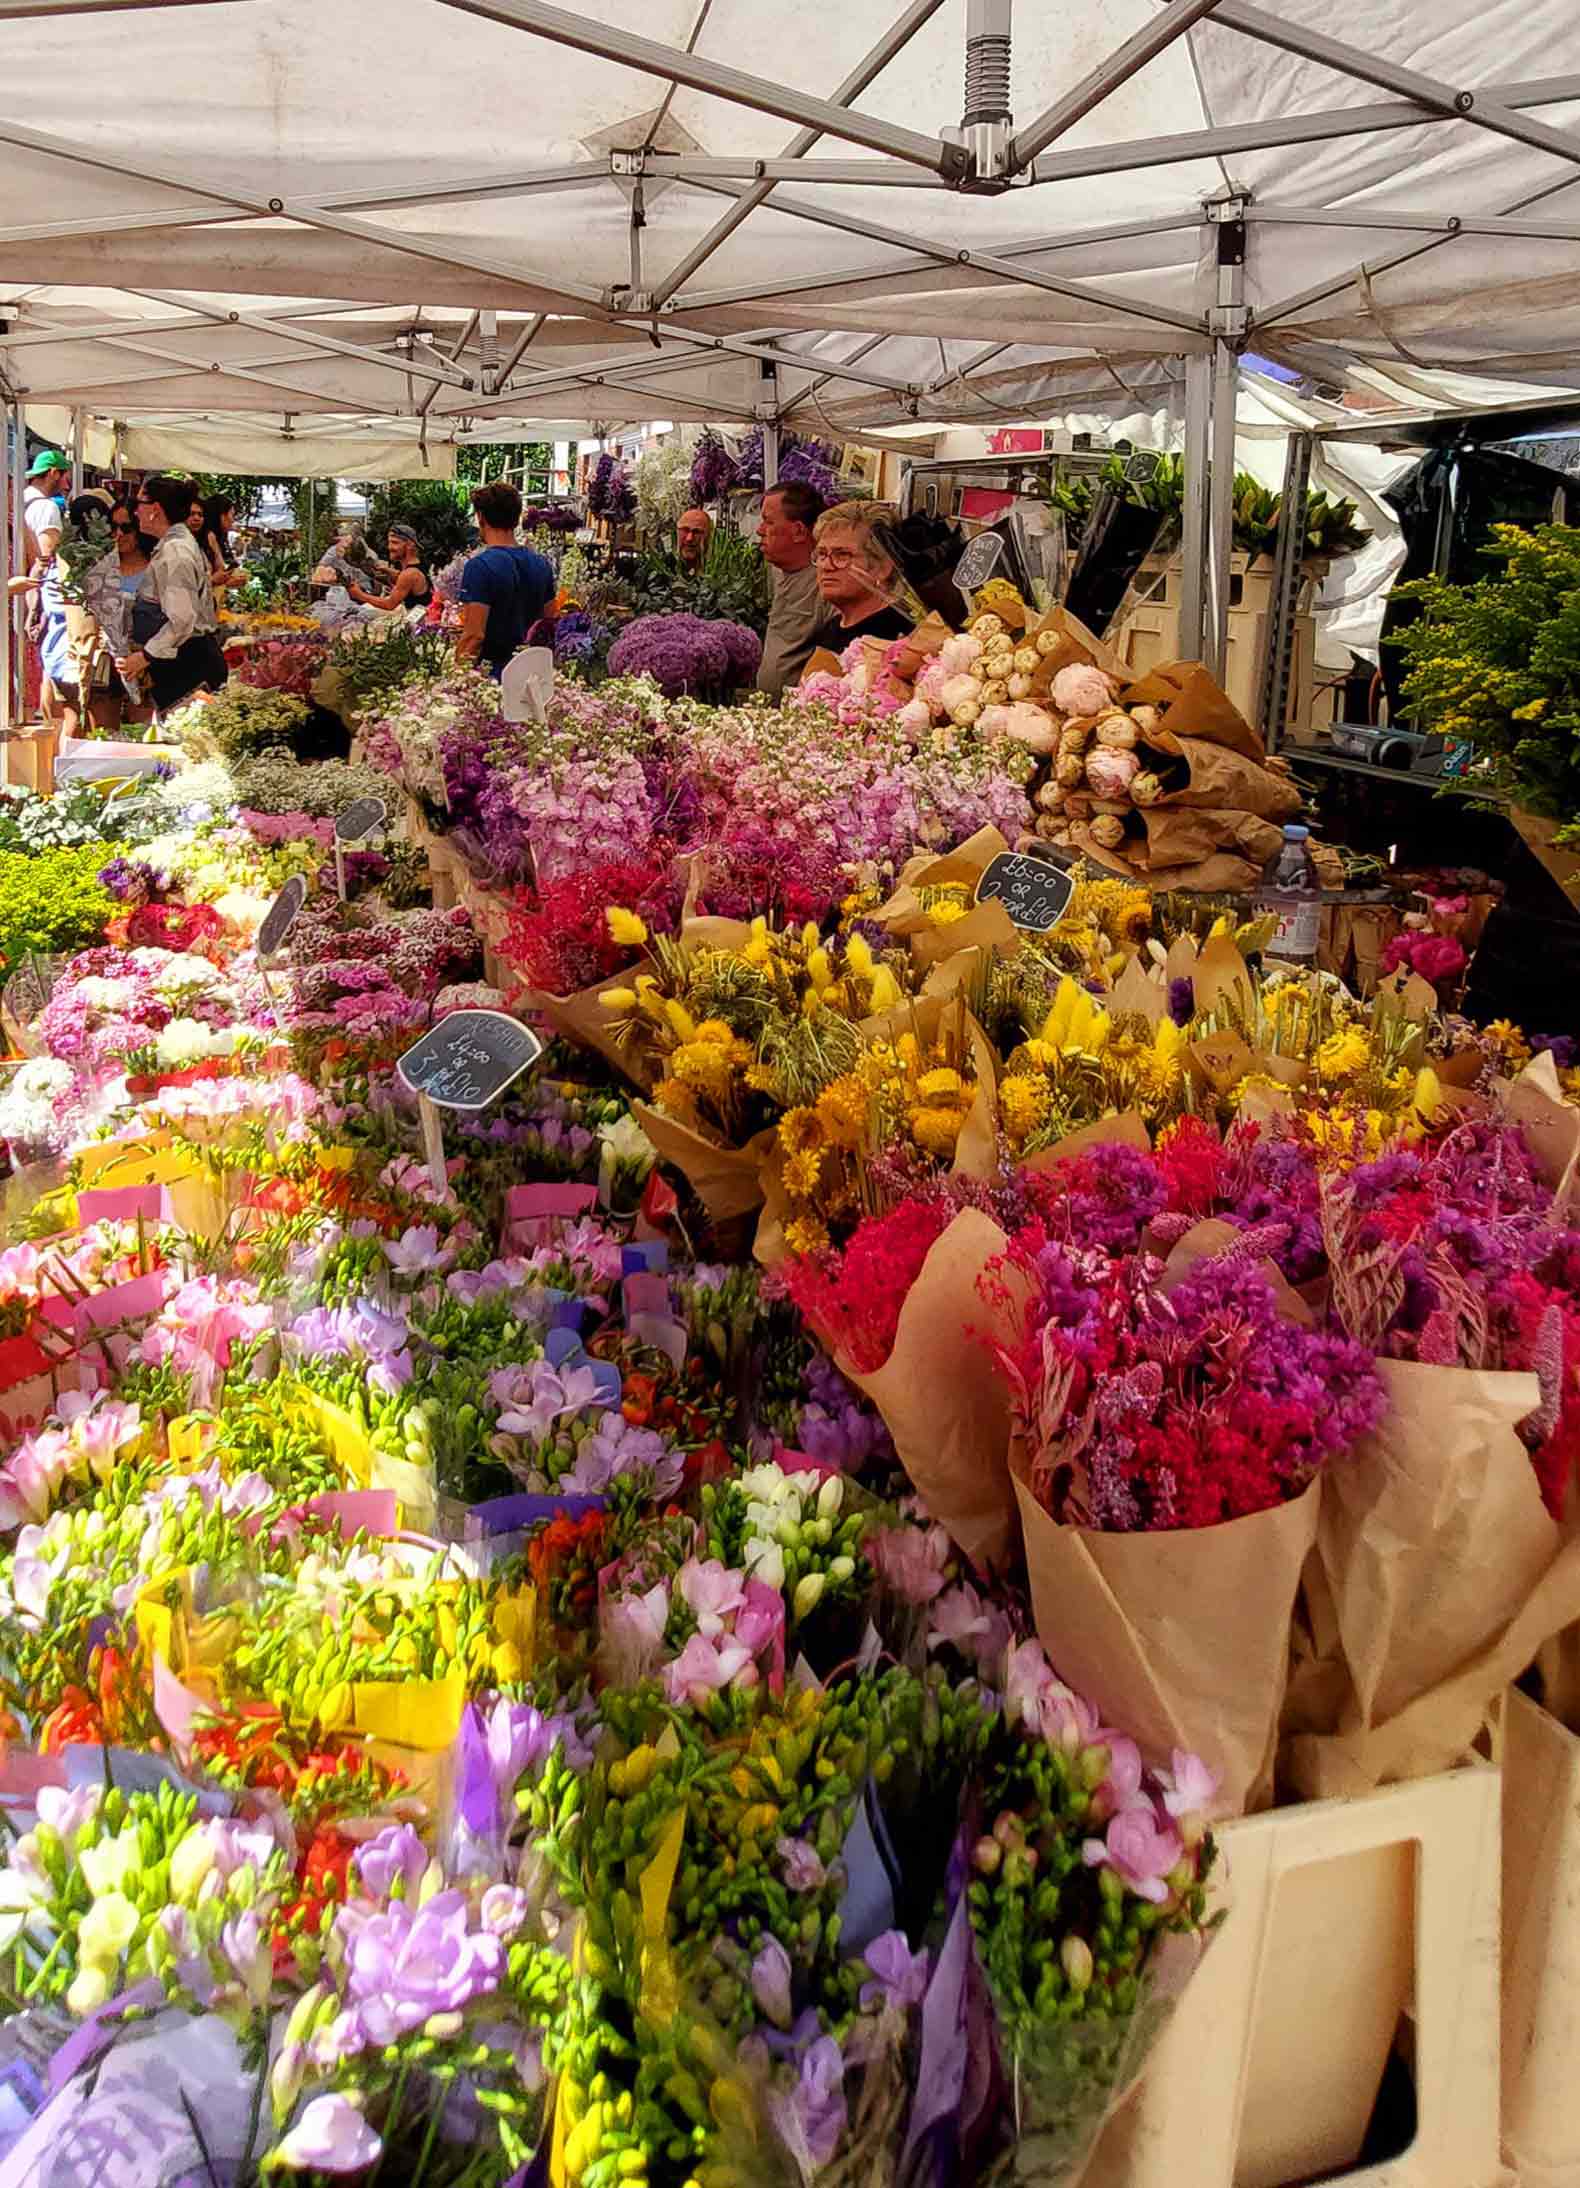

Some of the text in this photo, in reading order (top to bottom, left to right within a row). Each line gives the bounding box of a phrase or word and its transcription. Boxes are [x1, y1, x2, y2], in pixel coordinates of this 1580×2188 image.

[1011, 882, 1031, 899] OR
[1020, 896, 1058, 925] £10
[409, 1050, 438, 1076] 3
